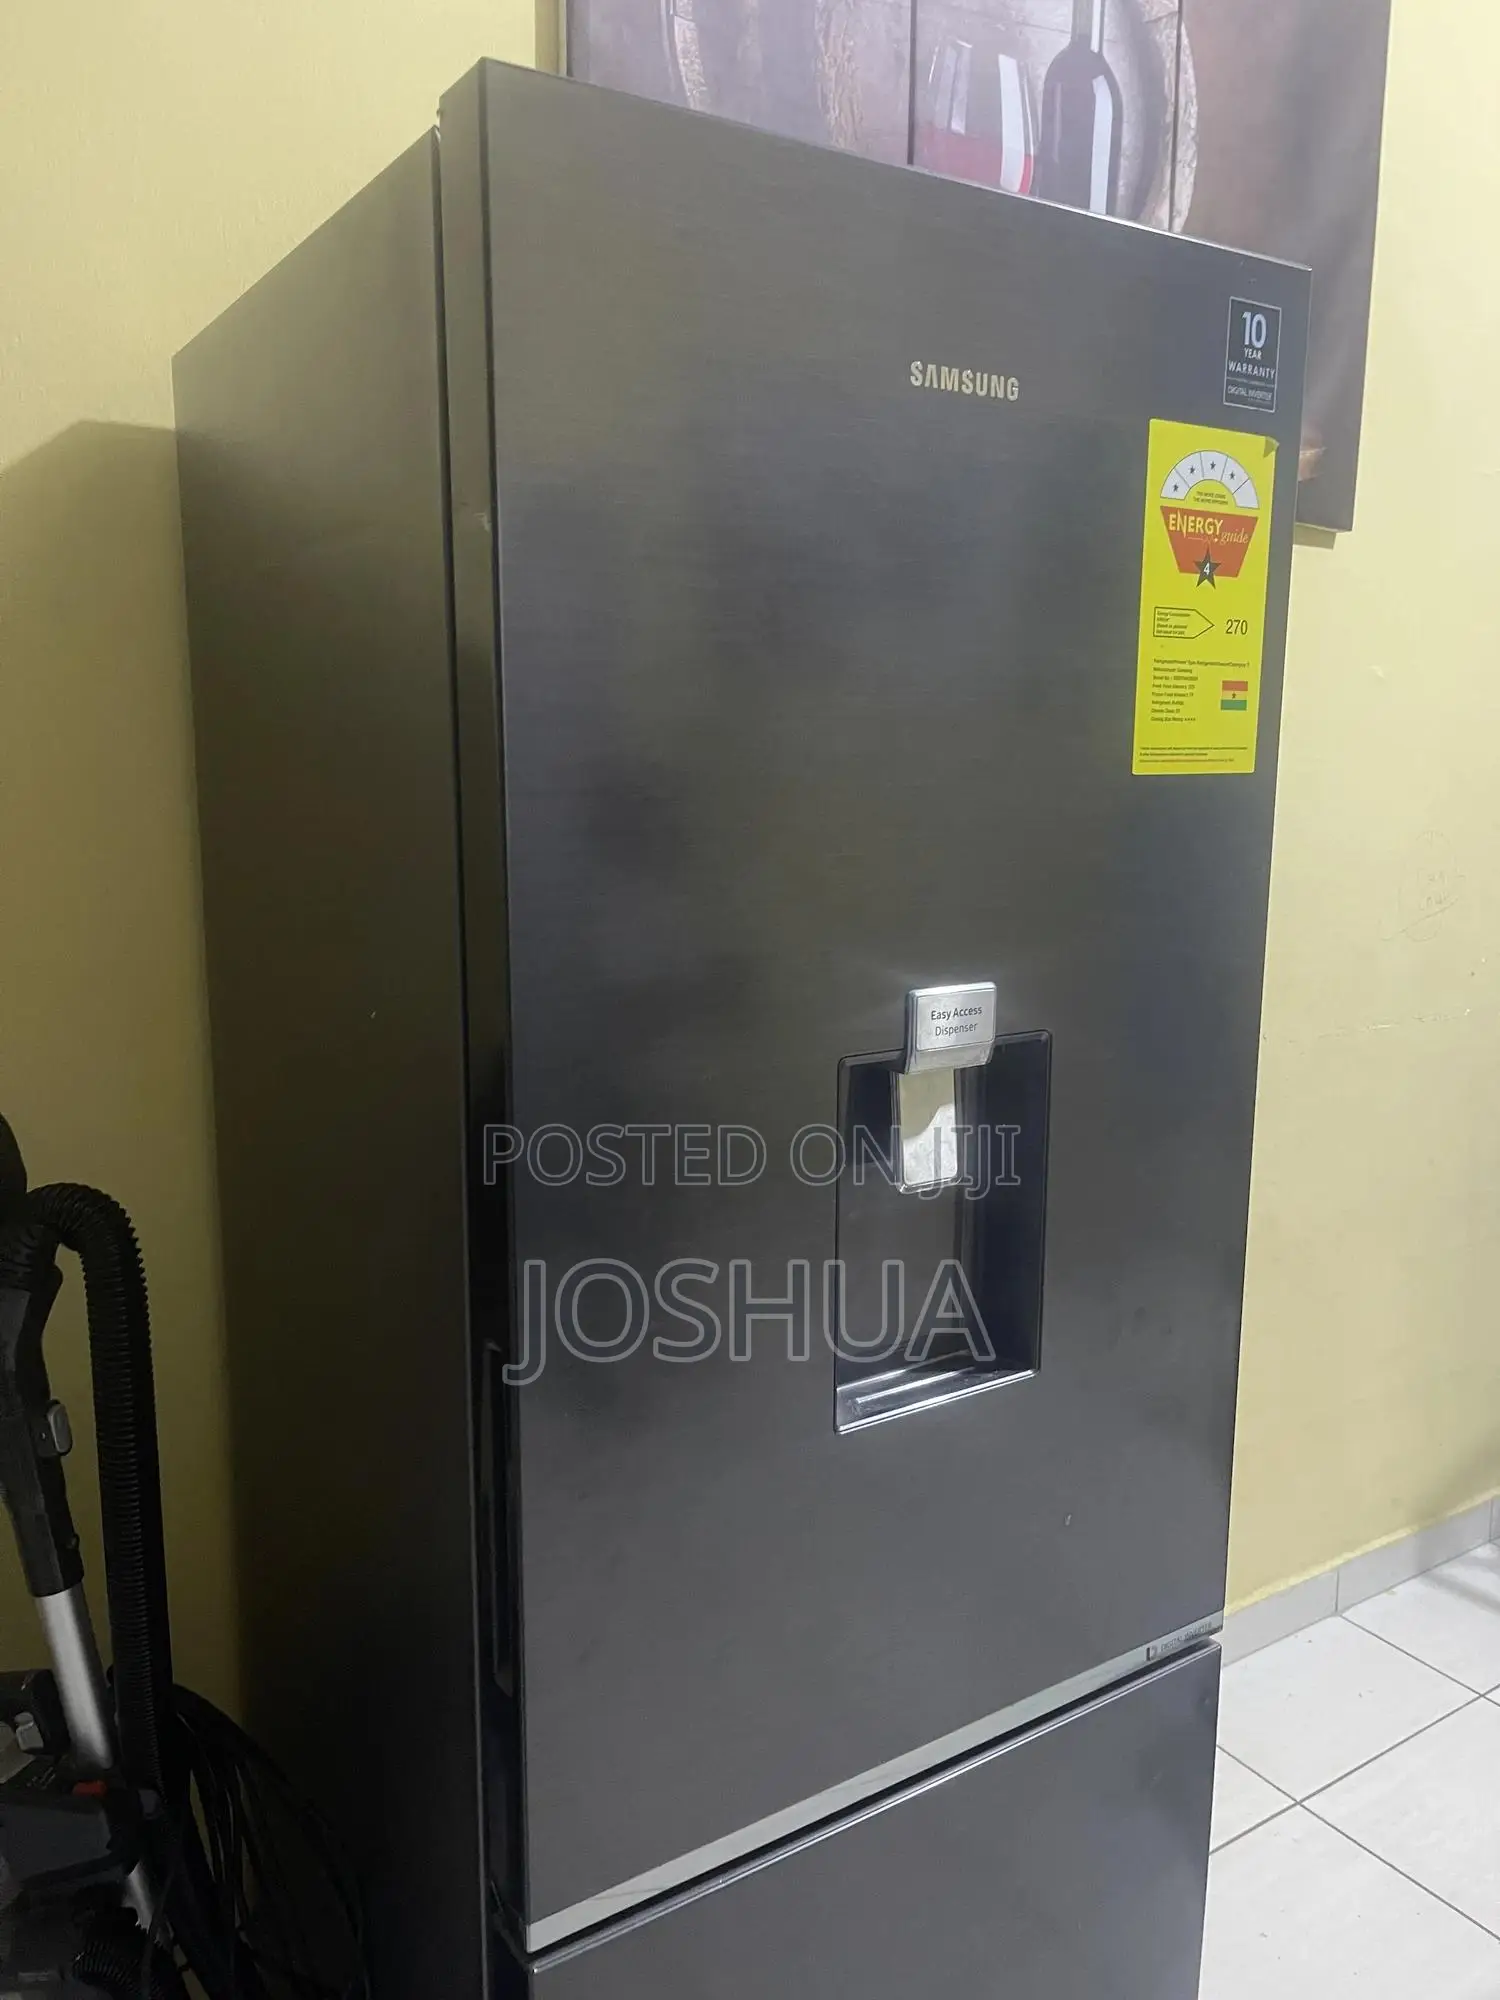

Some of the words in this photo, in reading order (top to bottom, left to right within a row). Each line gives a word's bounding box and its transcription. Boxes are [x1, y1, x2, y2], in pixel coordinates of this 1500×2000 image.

[1242, 311, 1267, 349] 10
[1244, 347, 1262, 360] YEAR
[1228, 360, 1277, 379] WARRANTY
[910, 360, 1020, 401] SAMSUNG
[1168, 510, 1223, 538] ENERGY
[1220, 528, 1249, 546] guide
[1202, 562, 1211, 576] 4
[1225, 618, 1249, 636] 270
[931, 1009, 952, 1022] Easy
[952, 1005, 983, 1018] Access
[935, 1022, 978, 1037] Dispenser
